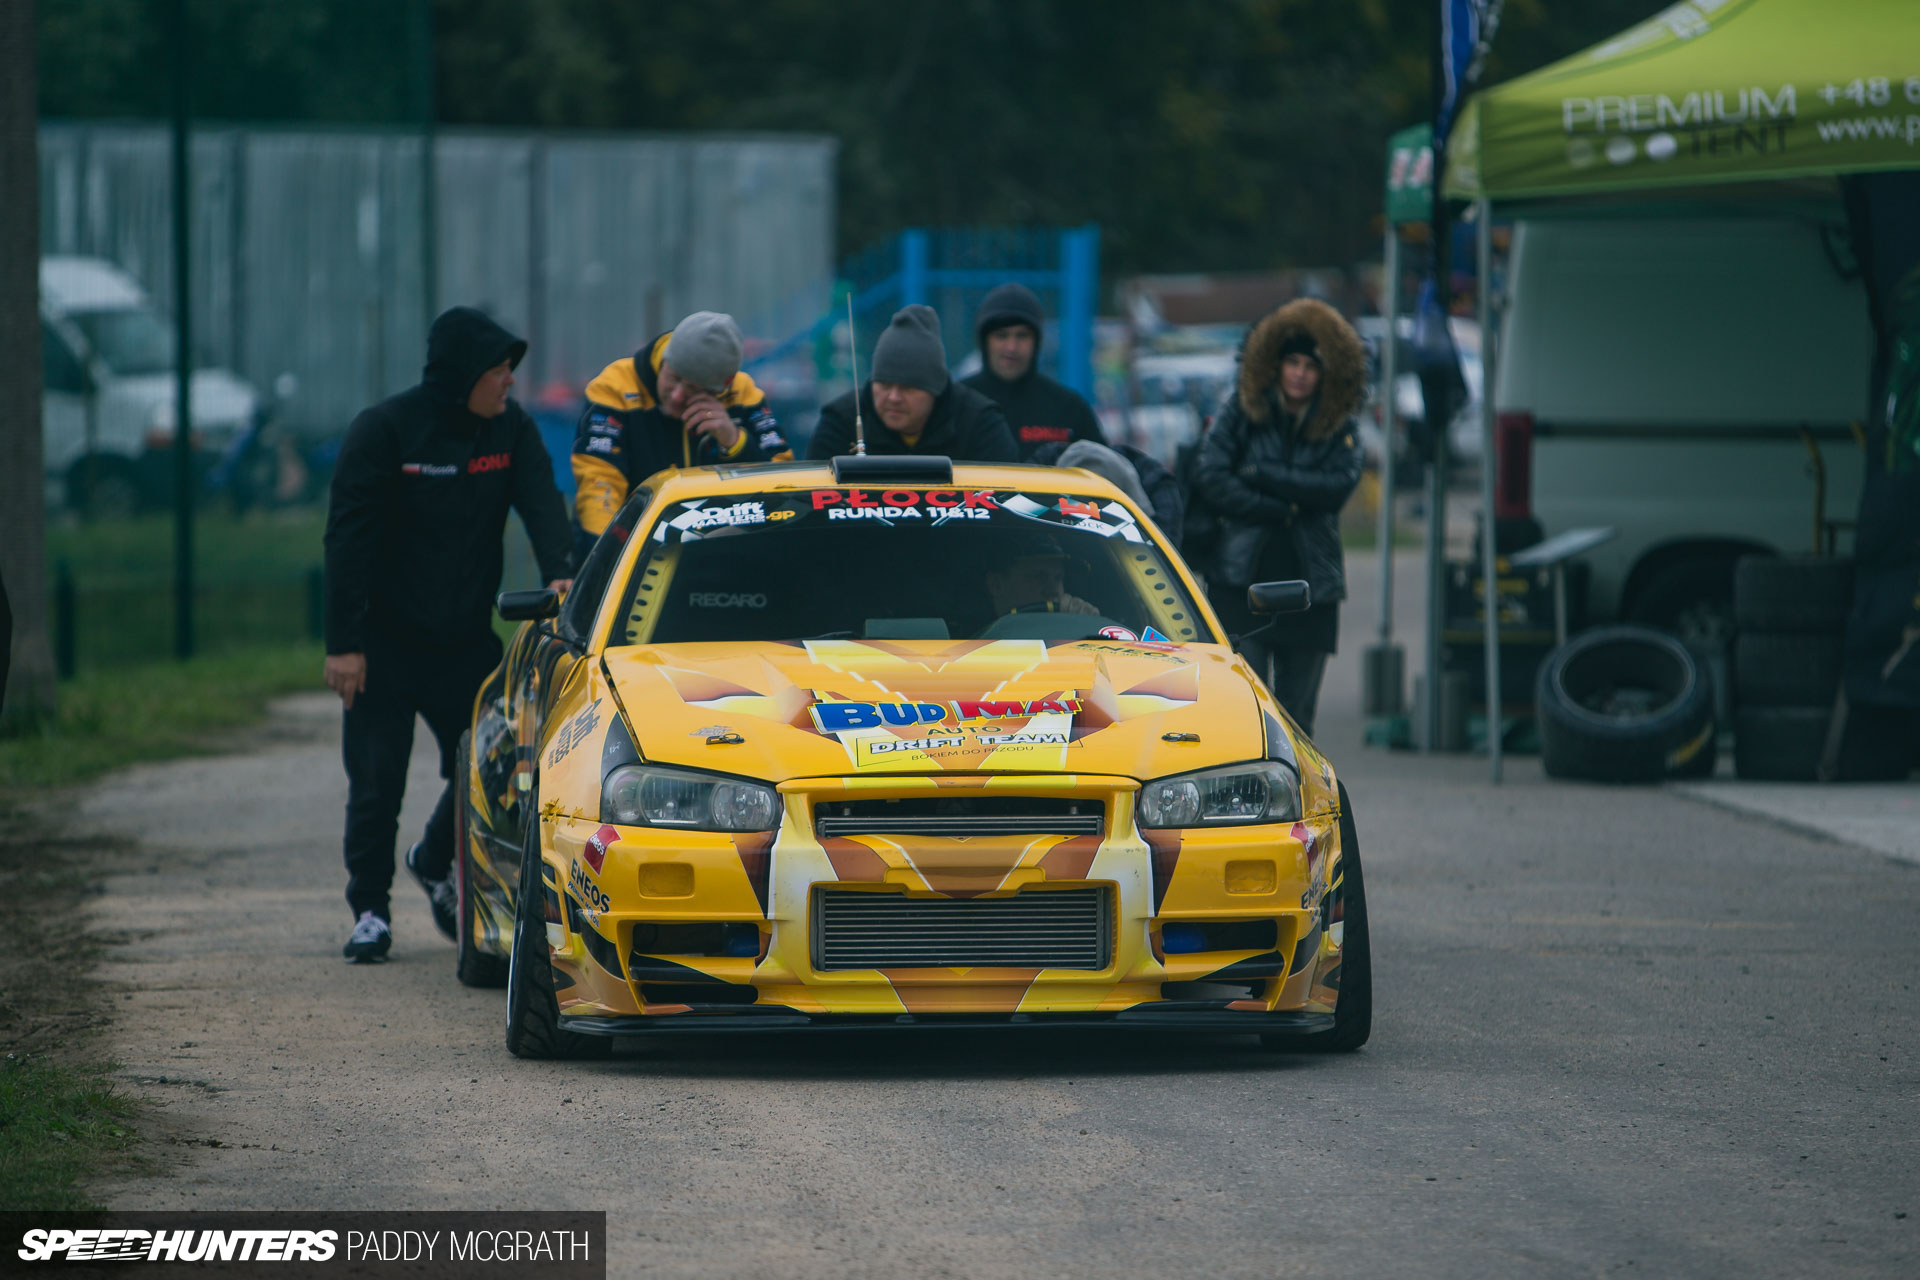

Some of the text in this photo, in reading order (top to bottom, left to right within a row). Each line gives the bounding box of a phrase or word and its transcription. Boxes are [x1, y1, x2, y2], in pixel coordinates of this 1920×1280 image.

[1563, 83, 1797, 132] PREMIUM
[1817, 76, 1891, 107] +48
[1691, 122, 1791, 157] TENT
[811, 489, 999, 510] PŁOCK
[702, 501, 765, 521] Drift
[829, 506, 991, 520] RUNDA 11&12
[689, 592, 767, 608] RECARO
[808, 699, 1081, 734] BUD MAT
[927, 726, 1002, 736] AUTO
[870, 733, 1069, 755] DRIFT TEAM
[911, 750, 959, 761] BOKIEM
[570, 857, 611, 914] ENEOS
